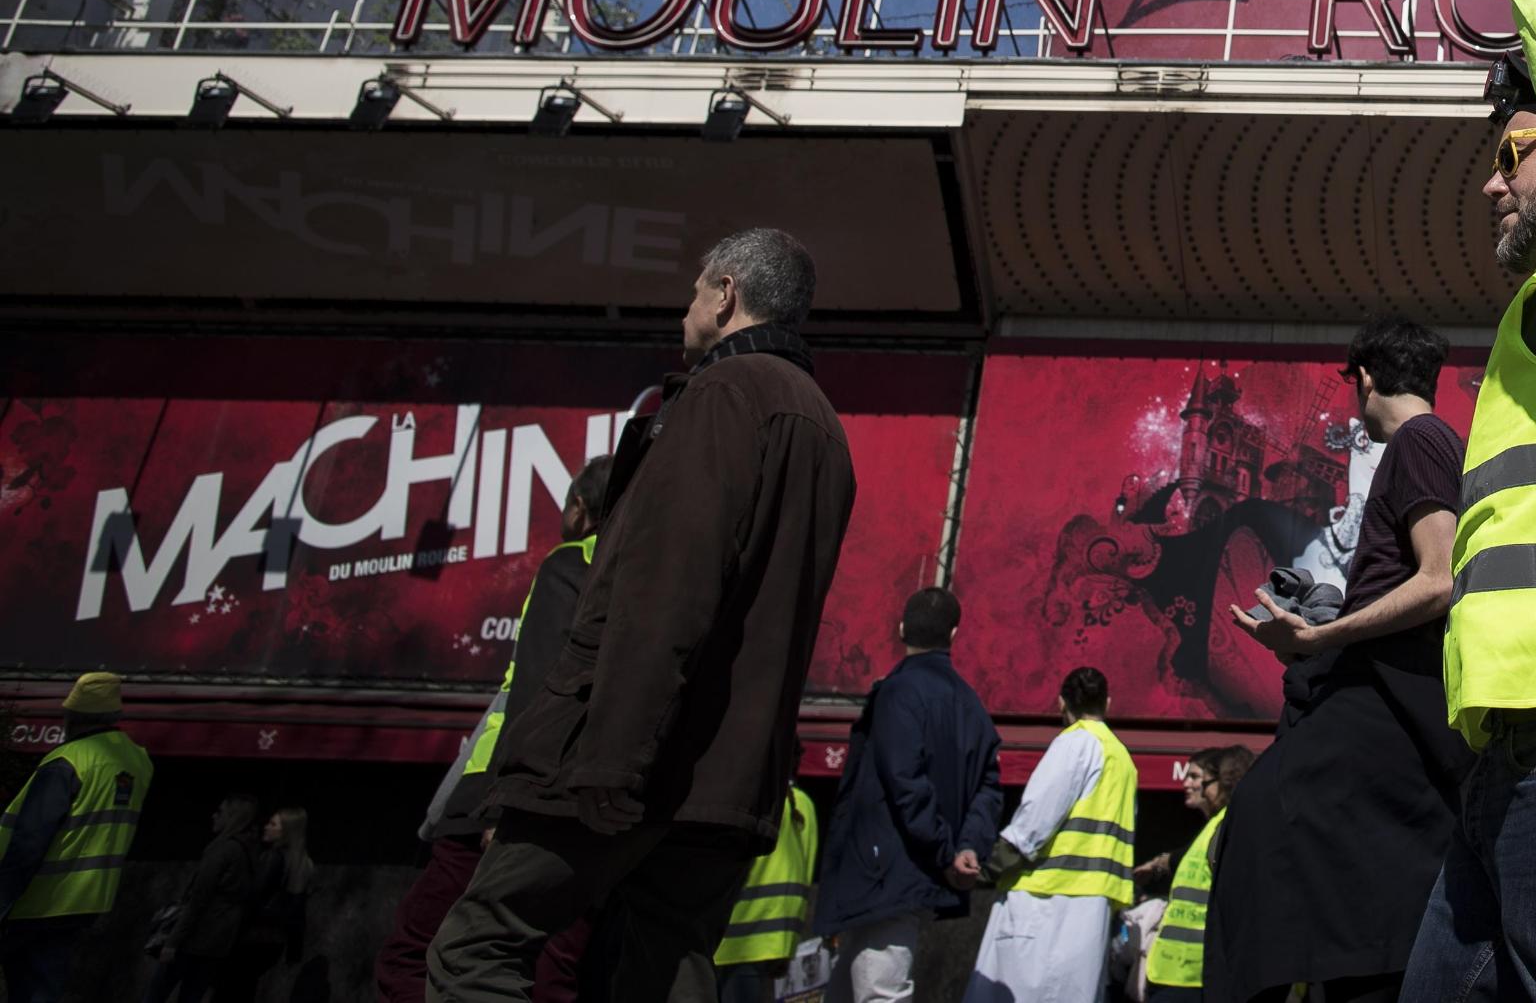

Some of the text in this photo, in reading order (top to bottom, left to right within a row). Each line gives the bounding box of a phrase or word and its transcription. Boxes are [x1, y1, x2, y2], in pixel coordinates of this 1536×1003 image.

[391, 410, 417, 429] LA
[328, 545, 468, 581] DU MOULIN ROUGE
